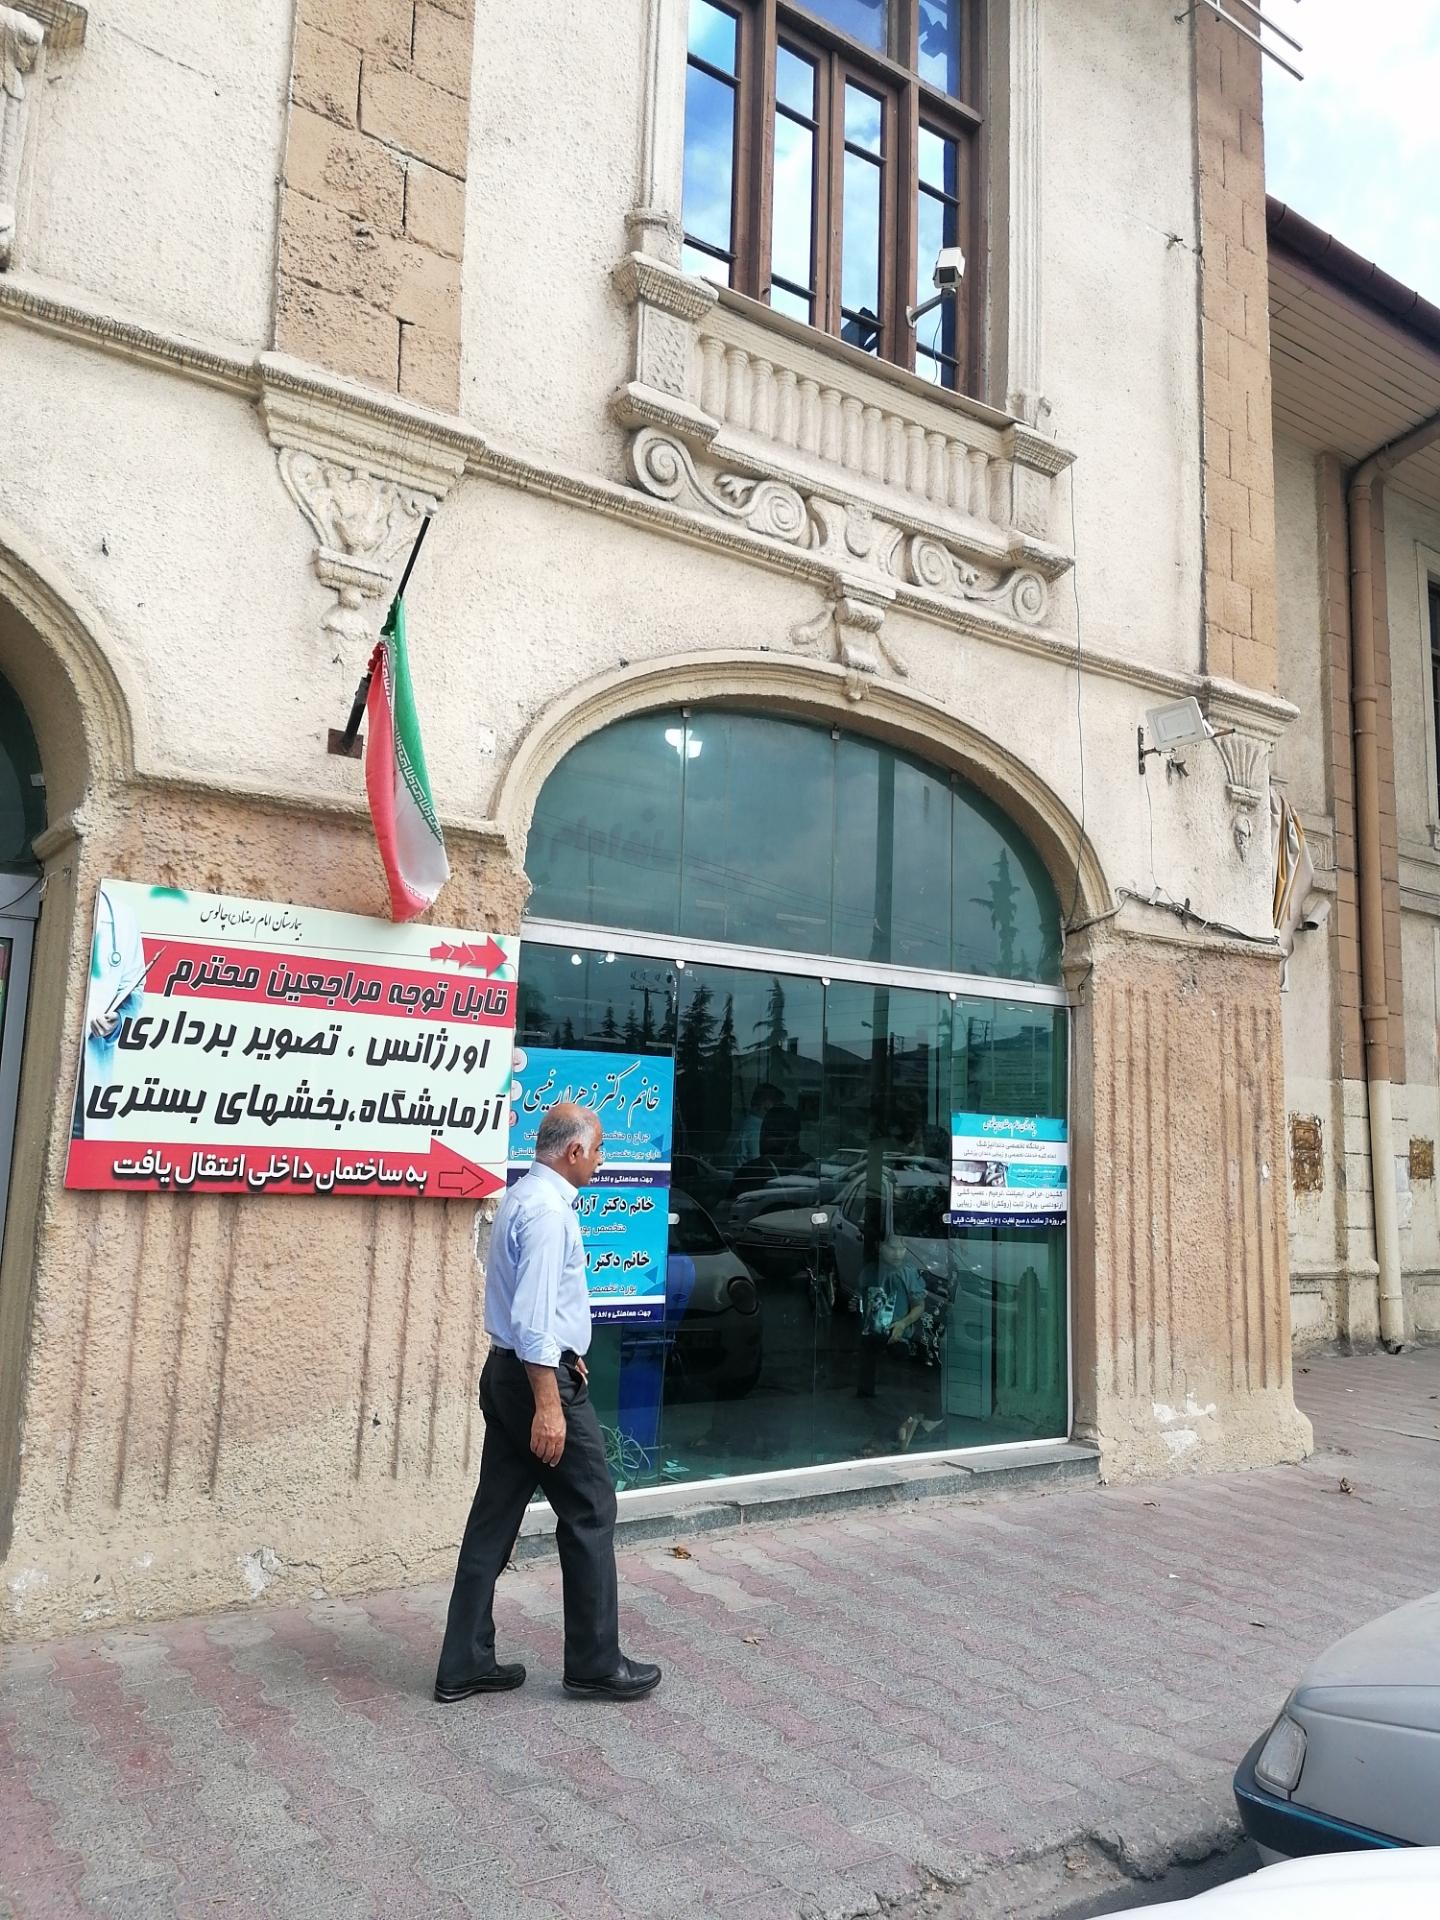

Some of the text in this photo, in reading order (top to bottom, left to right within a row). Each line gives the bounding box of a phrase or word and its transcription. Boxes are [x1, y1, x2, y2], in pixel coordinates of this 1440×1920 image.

[254, 914, 271, 938] امام
[272, 912, 302, 941] بیمارستان
[164, 955, 508, 1021] قابل توجه مراجعین محترم
[117, 1010, 238, 1058] برداری
[242, 1024, 343, 1061] تصویر
[365, 1027, 491, 1075] اورژانس
[593, 1059, 641, 1113] دکتر
[86, 1077, 208, 1124] بستری
[627, 1077, 661, 1128] خانم
[112, 1148, 428, 1196] به ساختمان داخلی انتقال یافت
[614, 1175, 639, 1183] هماهنگی
[600, 1196, 627, 1216] دکتر
[629, 1197, 655, 1216] خانم
[592, 1223, 627, 1236] متخصص
[592, 1251, 620, 1273] دکتر
[623, 1251, 651, 1272] خانم
[611, 1310, 637, 1318] هماهنگی
[638, 1310, 652, 1318] جهت
